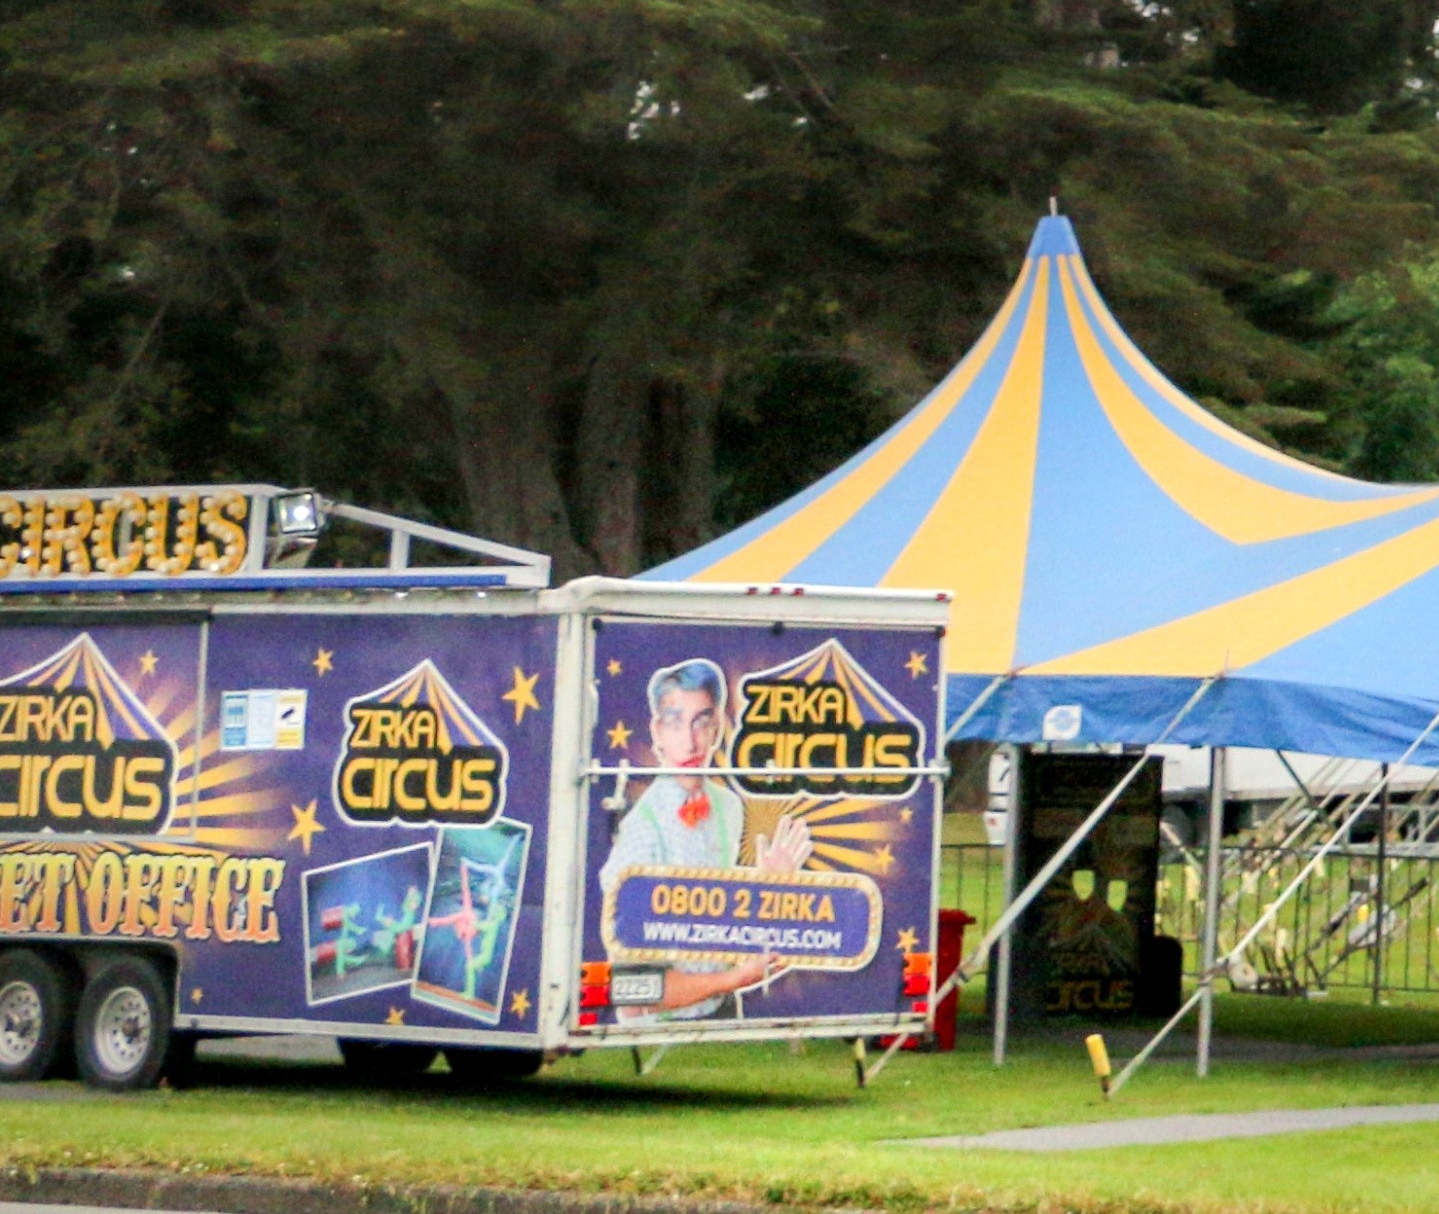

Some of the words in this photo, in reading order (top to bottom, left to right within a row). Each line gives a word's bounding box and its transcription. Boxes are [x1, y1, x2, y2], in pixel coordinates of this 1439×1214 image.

[746, 684, 845, 724] ZIRKA
[351, 708, 437, 748] ZIRKA
[86, 851, 286, 944] OFFICE
[652, 884, 727, 917] 0800
[733, 888, 751, 918] 2
[757, 890, 836, 923] ZIRKA
[643, 922, 842, 949] WWW.ZIRKACIRCUS.COM
